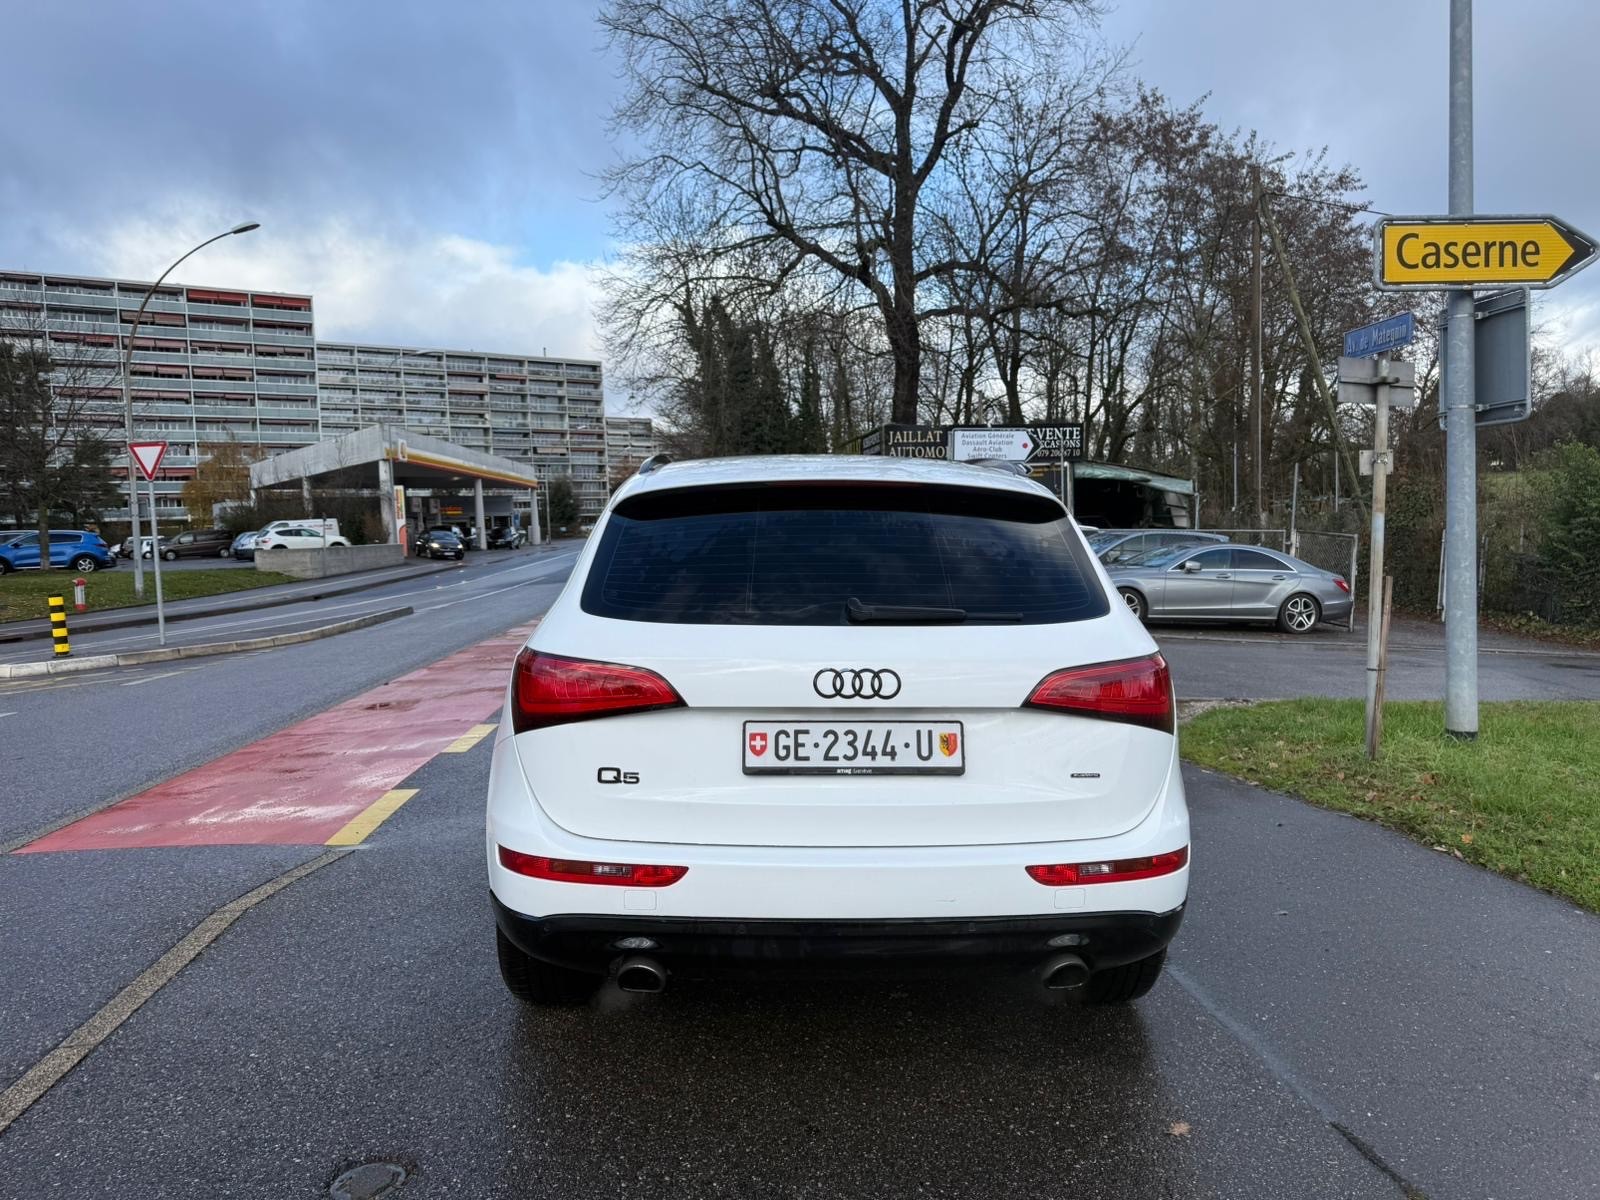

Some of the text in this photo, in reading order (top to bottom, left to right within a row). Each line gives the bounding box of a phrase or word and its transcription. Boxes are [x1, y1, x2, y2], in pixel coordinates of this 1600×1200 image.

[1396, 232, 1541, 270] Caserne
[888, 430, 943, 445] JAILLAT
[889, 446, 949, 458] AUTOMO
[597, 766, 640, 784] Q5
